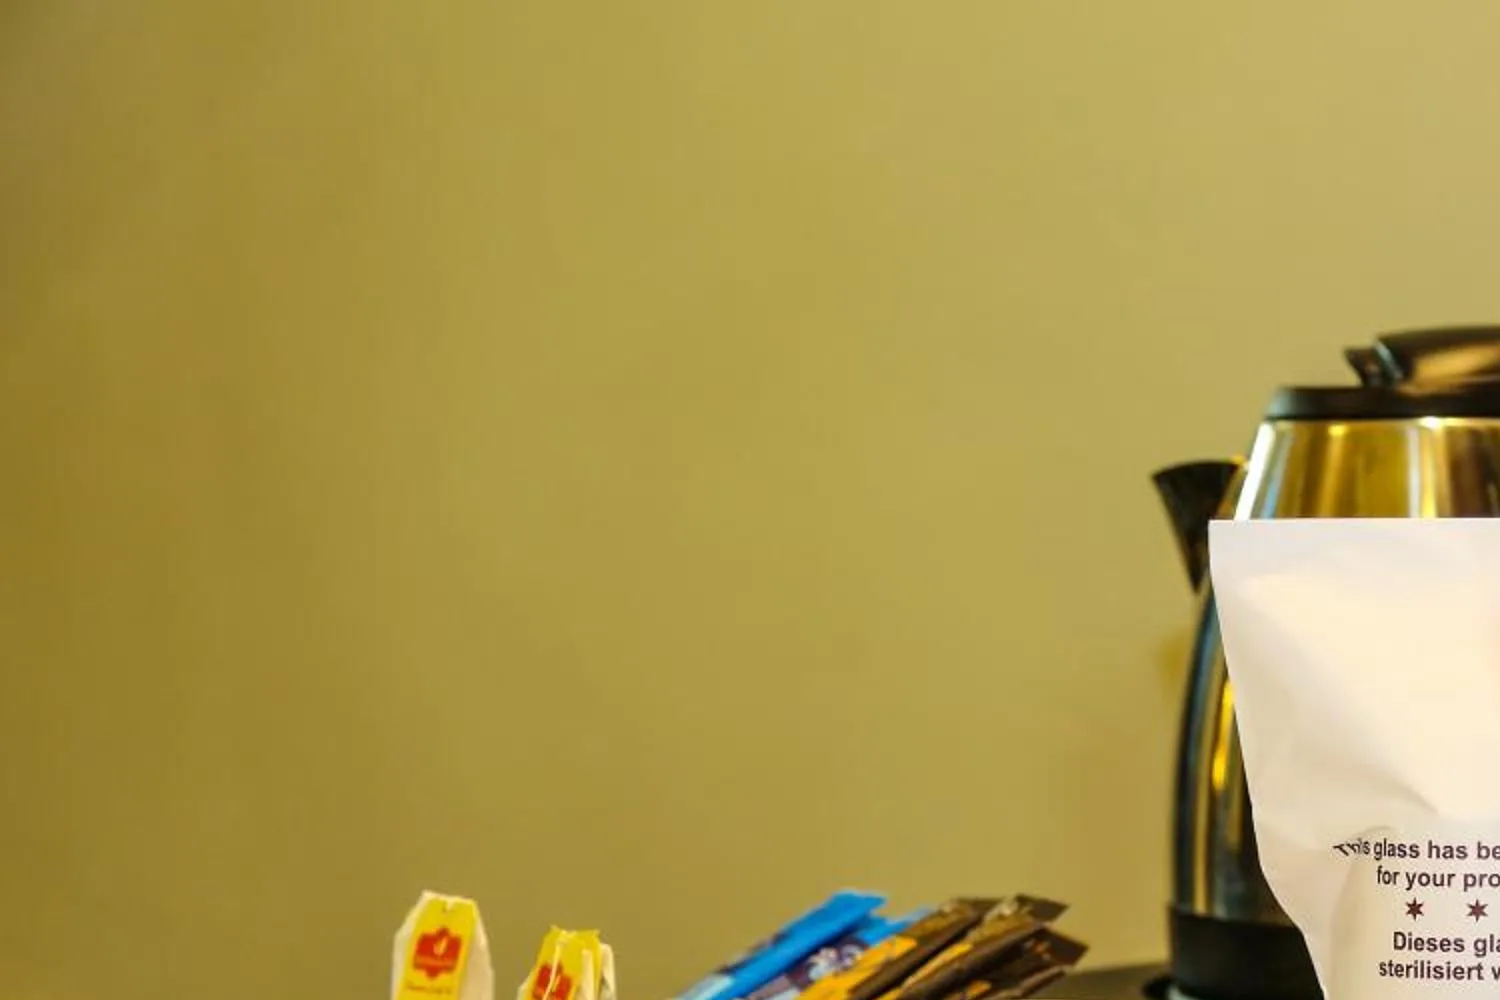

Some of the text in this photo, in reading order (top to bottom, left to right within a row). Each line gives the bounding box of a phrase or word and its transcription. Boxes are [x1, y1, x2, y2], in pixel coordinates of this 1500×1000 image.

[1373, 838, 1421, 861] glass
[1427, 840, 1469, 861] has
[1376, 865, 1400, 886] for
[1405, 872, 1456, 891] your
[1393, 931, 1466, 953] Dieses
[1379, 959, 1485, 981] sterilisiert
